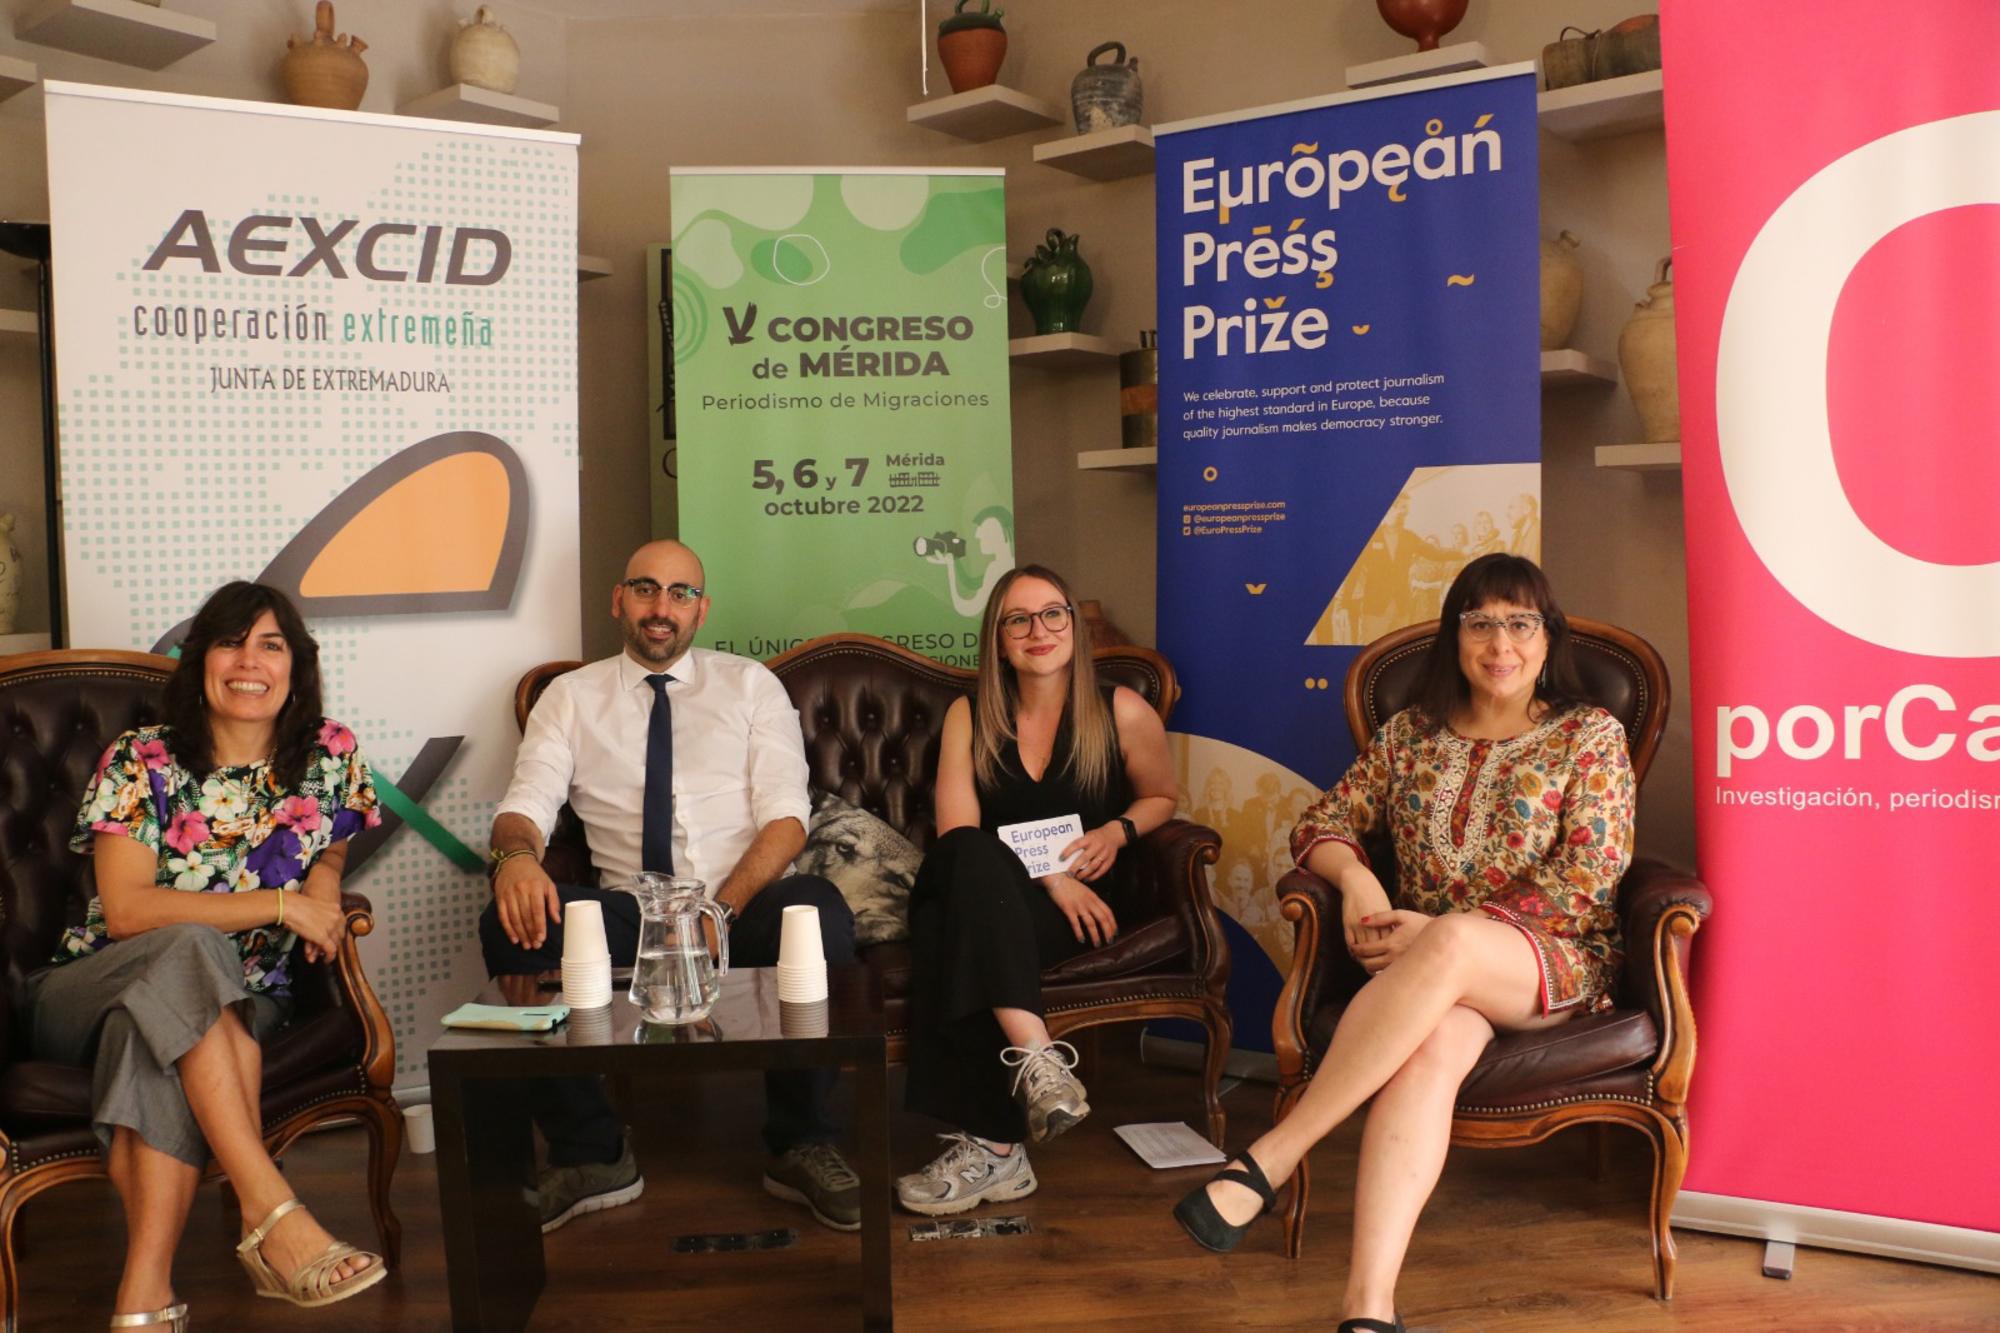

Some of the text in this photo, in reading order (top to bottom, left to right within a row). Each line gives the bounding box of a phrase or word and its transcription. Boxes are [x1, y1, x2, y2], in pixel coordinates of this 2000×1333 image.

[141, 209, 512, 286] AEXCID
[134, 303, 492, 347] cooperación extremeña
[767, 315, 974, 343] CONGRESO
[752, 345, 951, 380] de MÉRIDA
[209, 367, 451, 393] JUNTA DE EXTREMADURA
[1183, 391, 1200, 402] We
[1261, 384, 1307, 398] support
[1310, 381, 1333, 393] and
[1336, 378, 1380, 394] protect
[1383, 373, 1445, 391] journalism
[702, 389, 990, 411] Periodismo de Migraciones
[1183, 410, 1197, 421] of
[1197, 408, 1216, 420] the
[1218, 405, 1260, 420] highest
[1263, 401, 1315, 415] standard
[1318, 401, 1329, 412] in
[1379, 395, 1431, 408] because
[1183, 414, 1444, 440] quality journalism makes democracy stronger.
[886, 453, 946, 467] Mérida
[752, 457, 870, 496] 5, 6 y 7
[764, 495, 925, 516] octubre 2022
[749, 635, 815, 656] ÚNIC
[882, 633, 955, 650] RESO
[963, 632, 979, 649] D
[1715, 785, 1881, 811] Investigación,
[1026, 861, 1051, 874] rize
